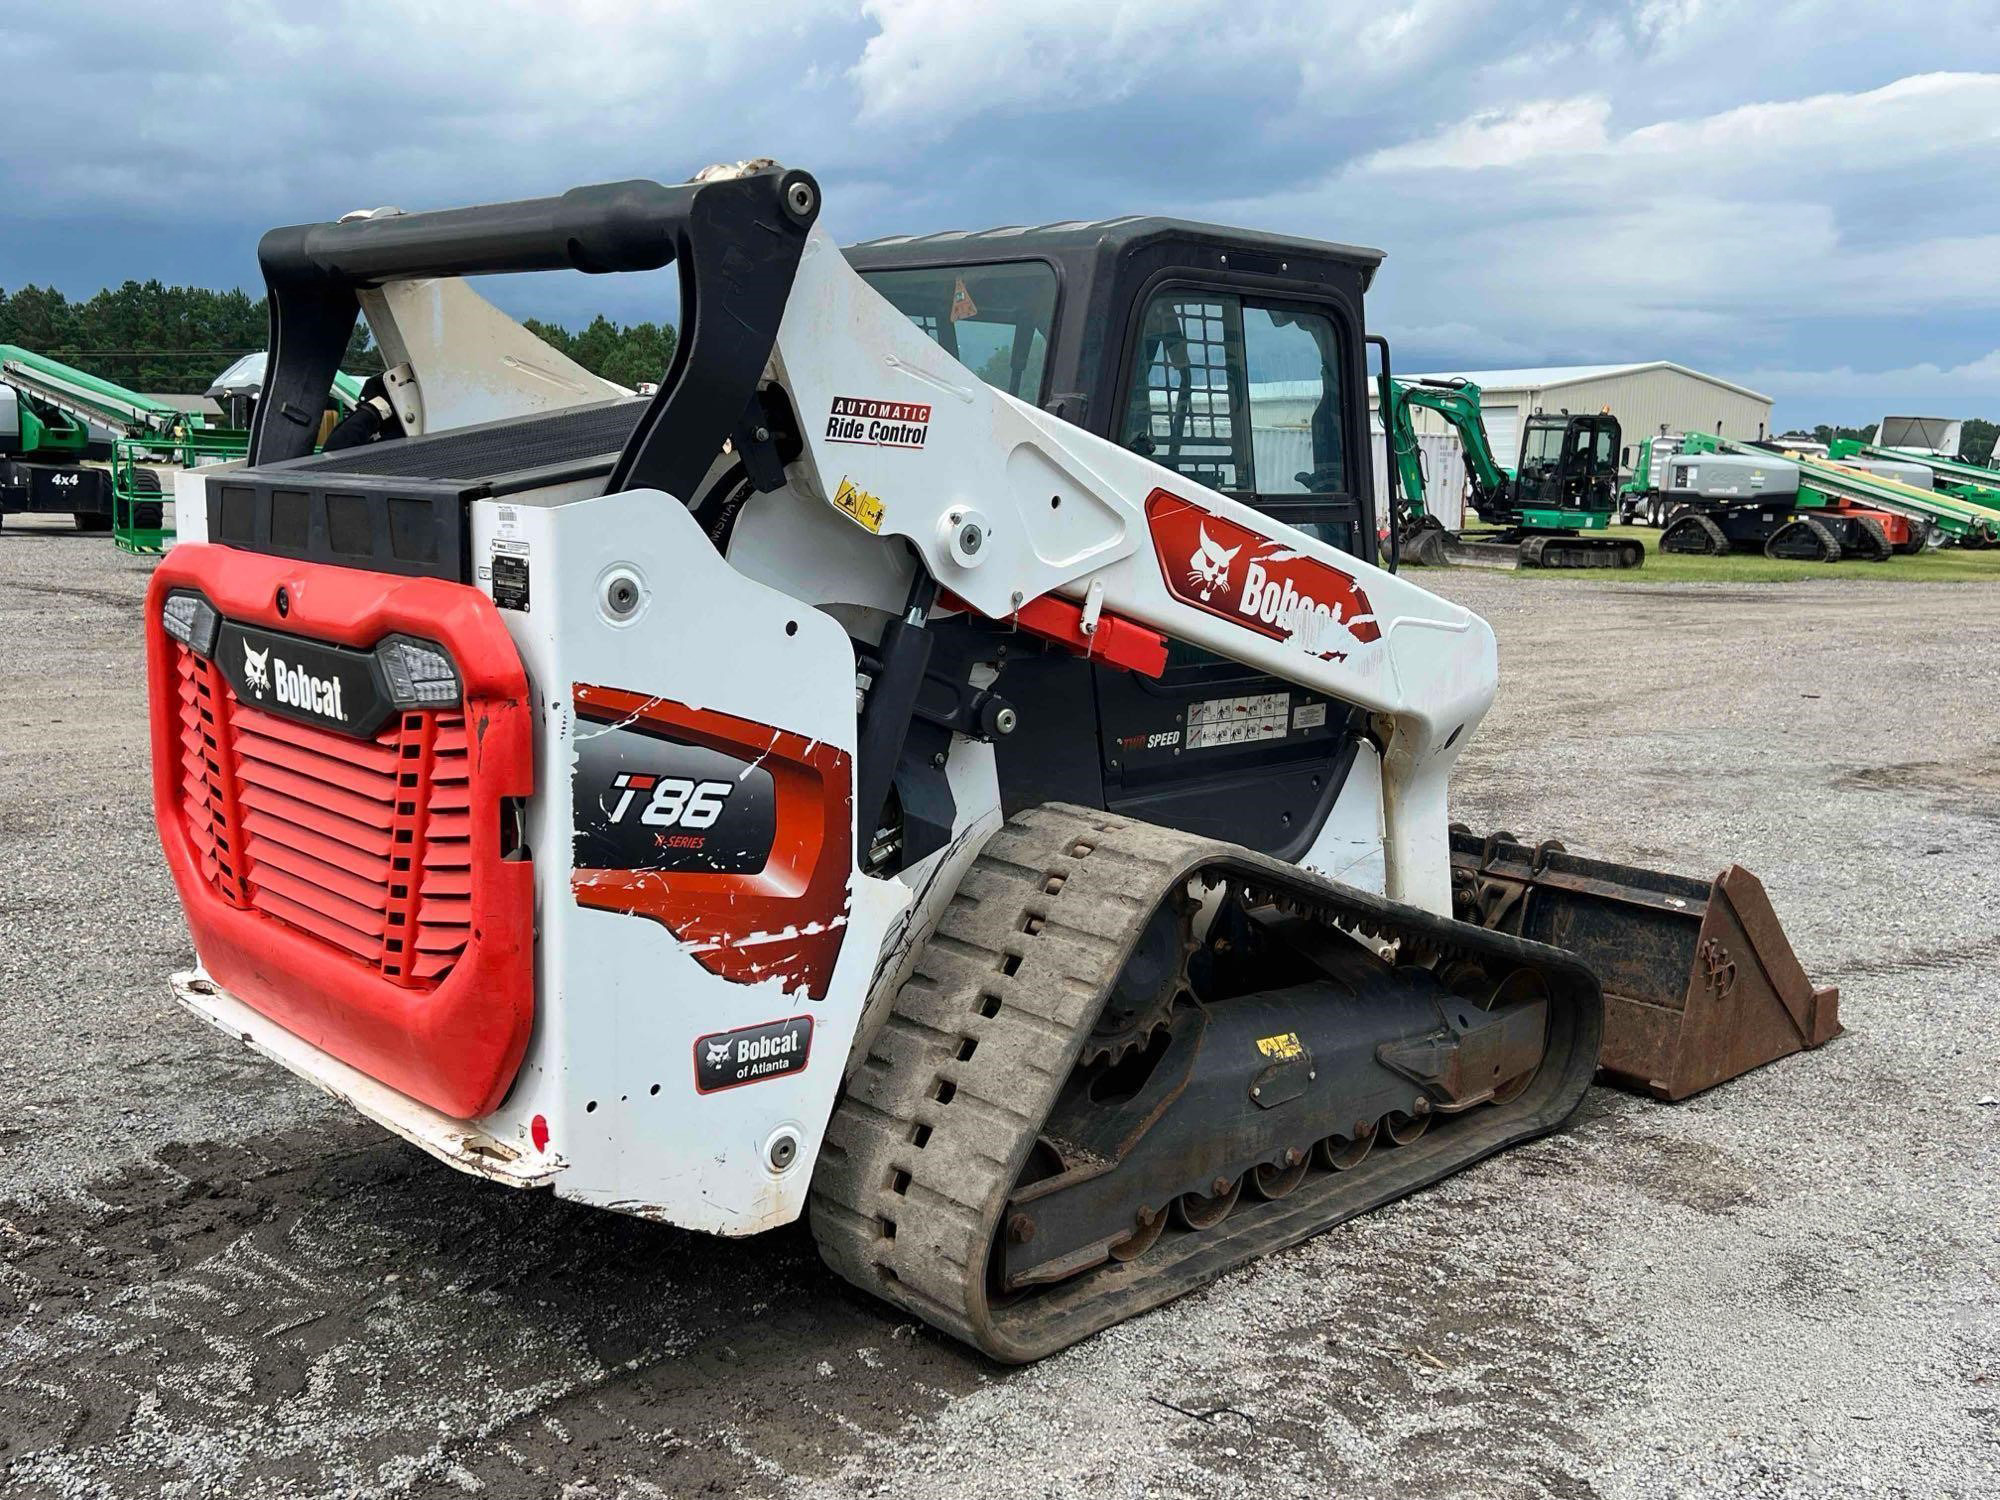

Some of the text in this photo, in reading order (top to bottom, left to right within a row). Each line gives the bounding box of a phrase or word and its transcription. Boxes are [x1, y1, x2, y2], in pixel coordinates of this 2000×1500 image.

[834, 400, 928, 421] AUTOMATIC
[825, 416, 929, 445] Ride Control
[51, 473, 79, 486] 4x4
[273, 657, 344, 721] Bobcat
[1147, 730, 1181, 749] SPEED
[609, 774, 734, 829] T86
[653, 834, 706, 849] R-SERIES
[736, 1030, 799, 1064] Bobcat
[736, 1059, 790, 1080] of Atlanta
